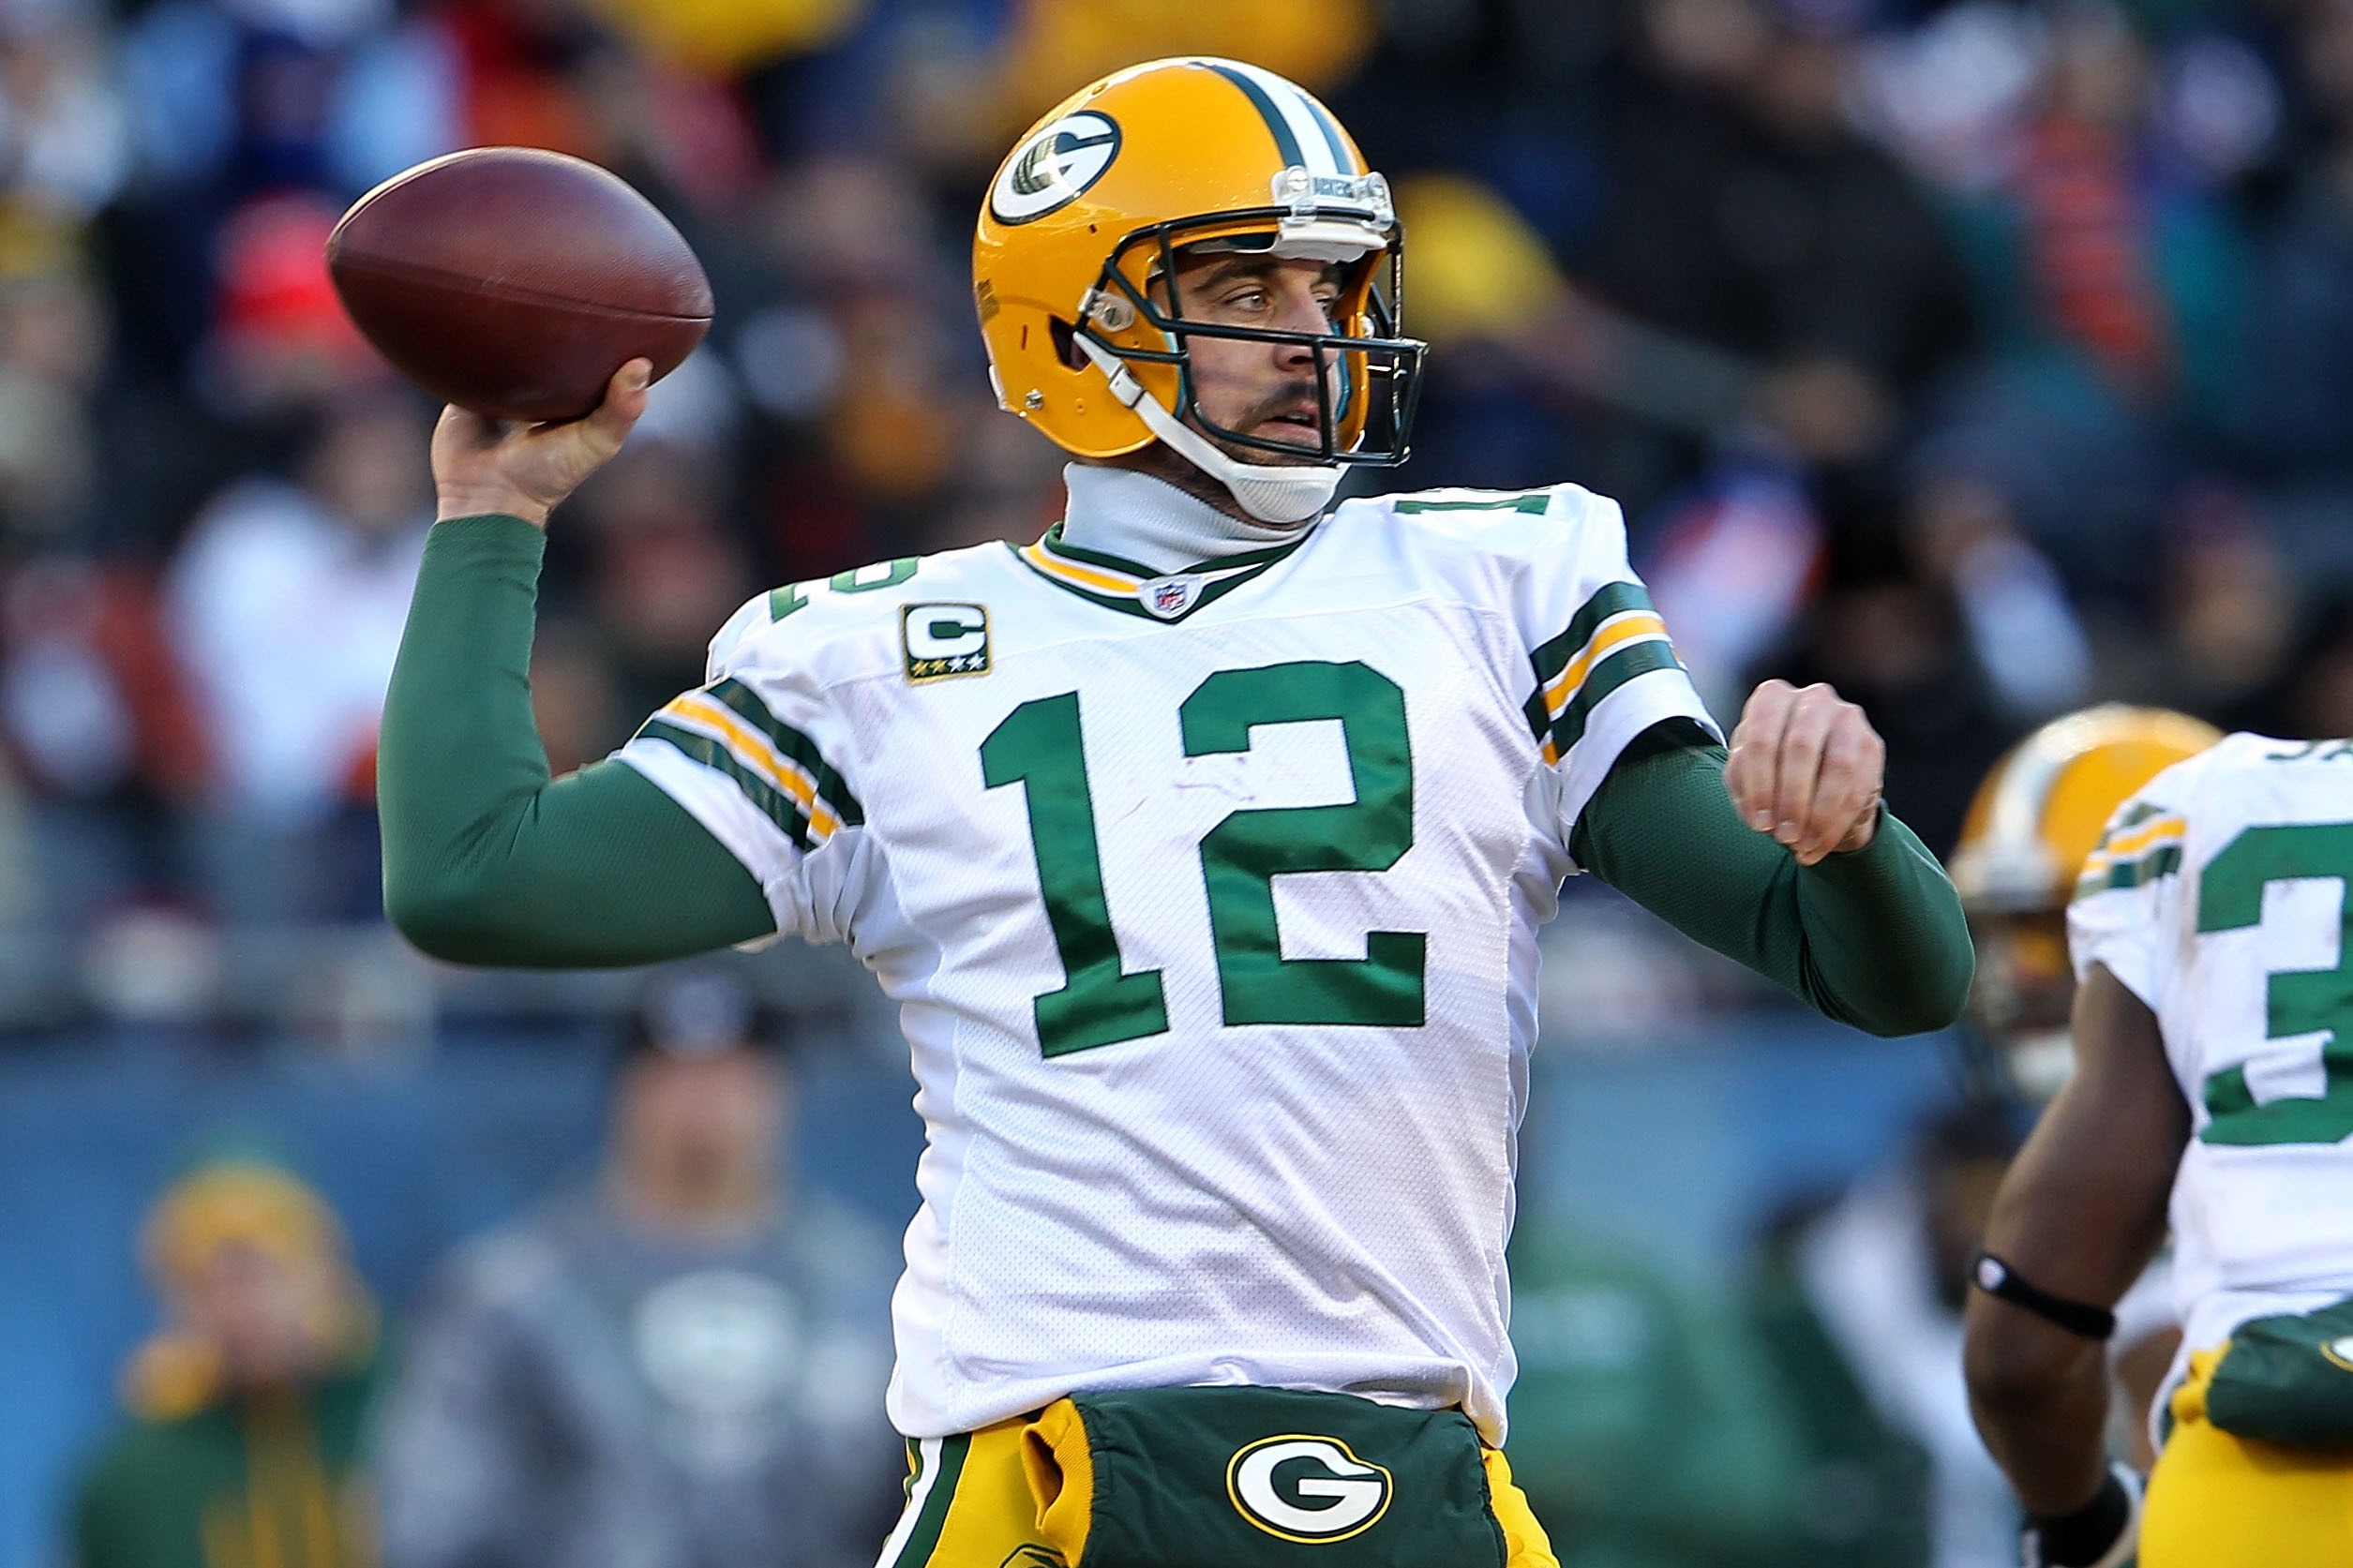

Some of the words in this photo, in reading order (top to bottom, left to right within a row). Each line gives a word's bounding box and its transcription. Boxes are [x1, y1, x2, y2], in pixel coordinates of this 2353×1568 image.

[991, 112, 1121, 224] G
[905, 605, 987, 660] C
[979, 660, 1427, 1059] 12
[1236, 1441, 1383, 1533] G
